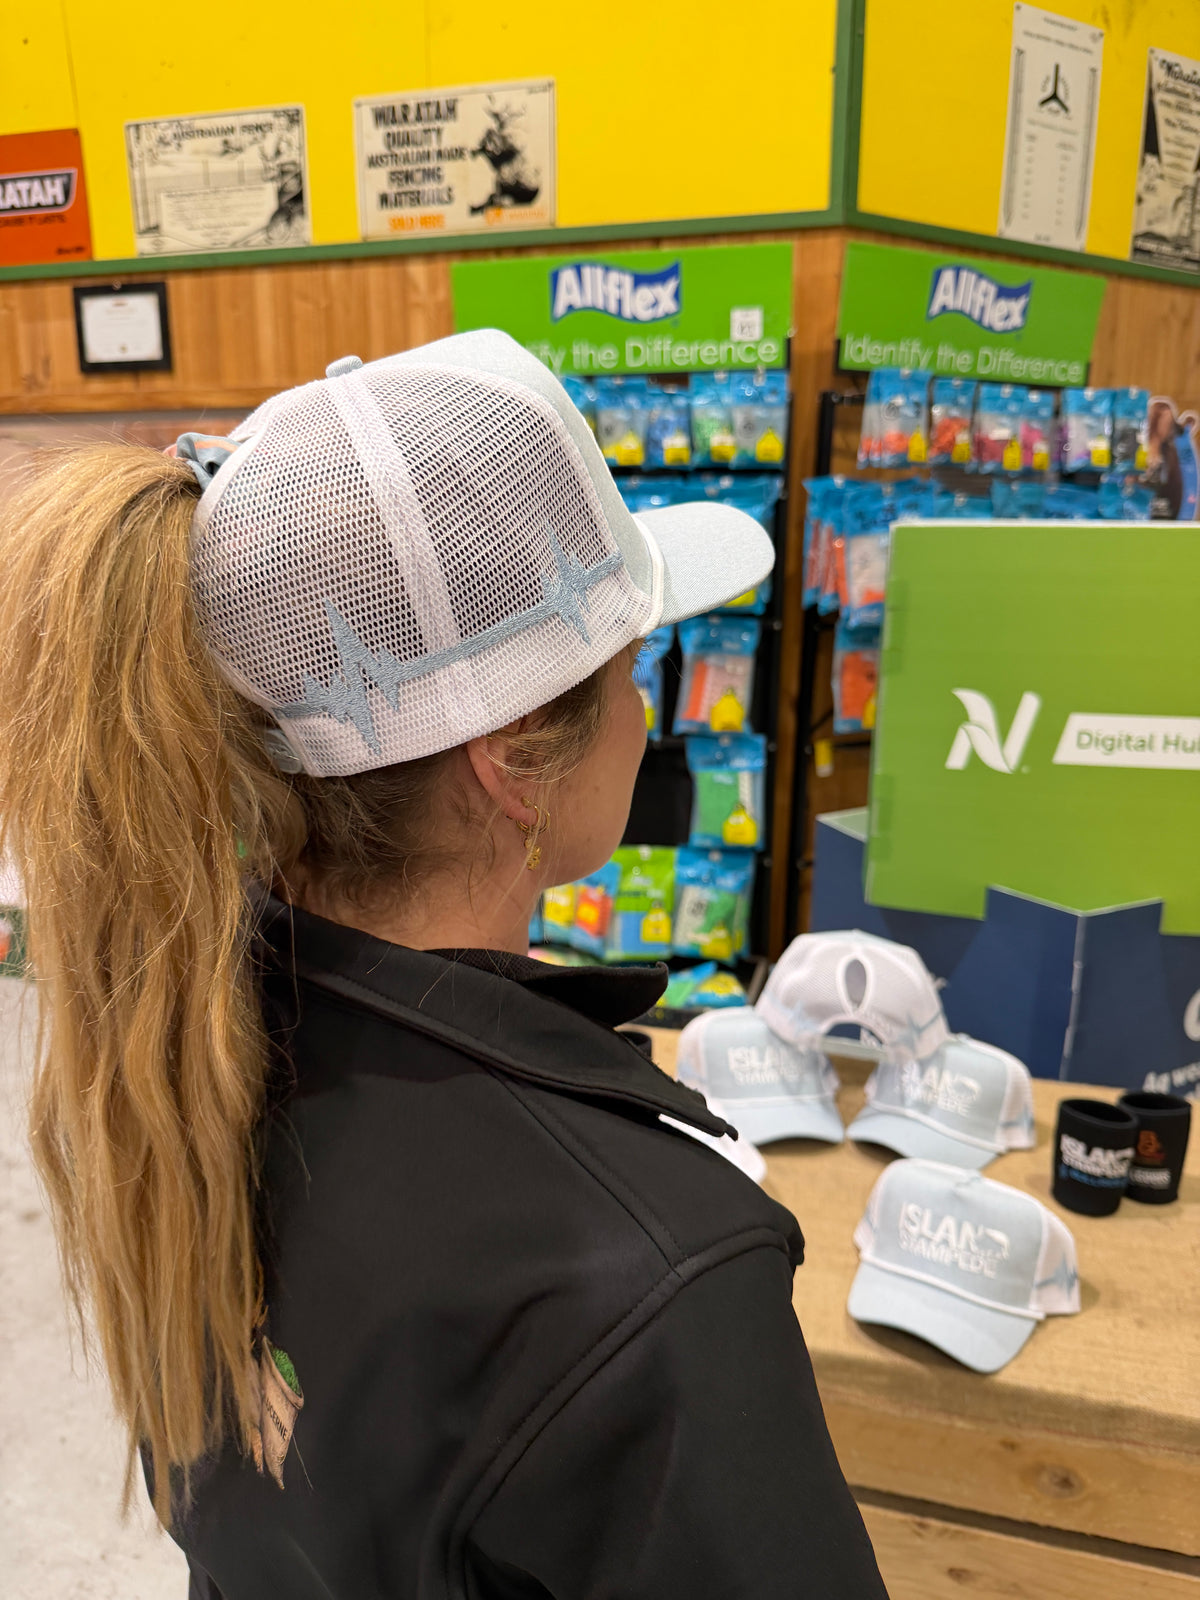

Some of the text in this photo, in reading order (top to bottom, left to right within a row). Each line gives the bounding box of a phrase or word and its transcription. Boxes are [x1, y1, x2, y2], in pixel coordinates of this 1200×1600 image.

[372, 98, 459, 128] WARATAH
[384, 127, 444, 150] QUALITY
[0, 174, 66, 210] ATAH
[388, 166, 444, 187] FENCING
[553, 263, 681, 322] Allflex
[928, 267, 1030, 332] Allflex
[572, 339, 619, 370] the
[625, 335, 780, 368] Difference
[844, 334, 1083, 383] Identify the Difference
[1075, 729, 1155, 755] Digital
[265, 1397, 288, 1441] UCERNE
